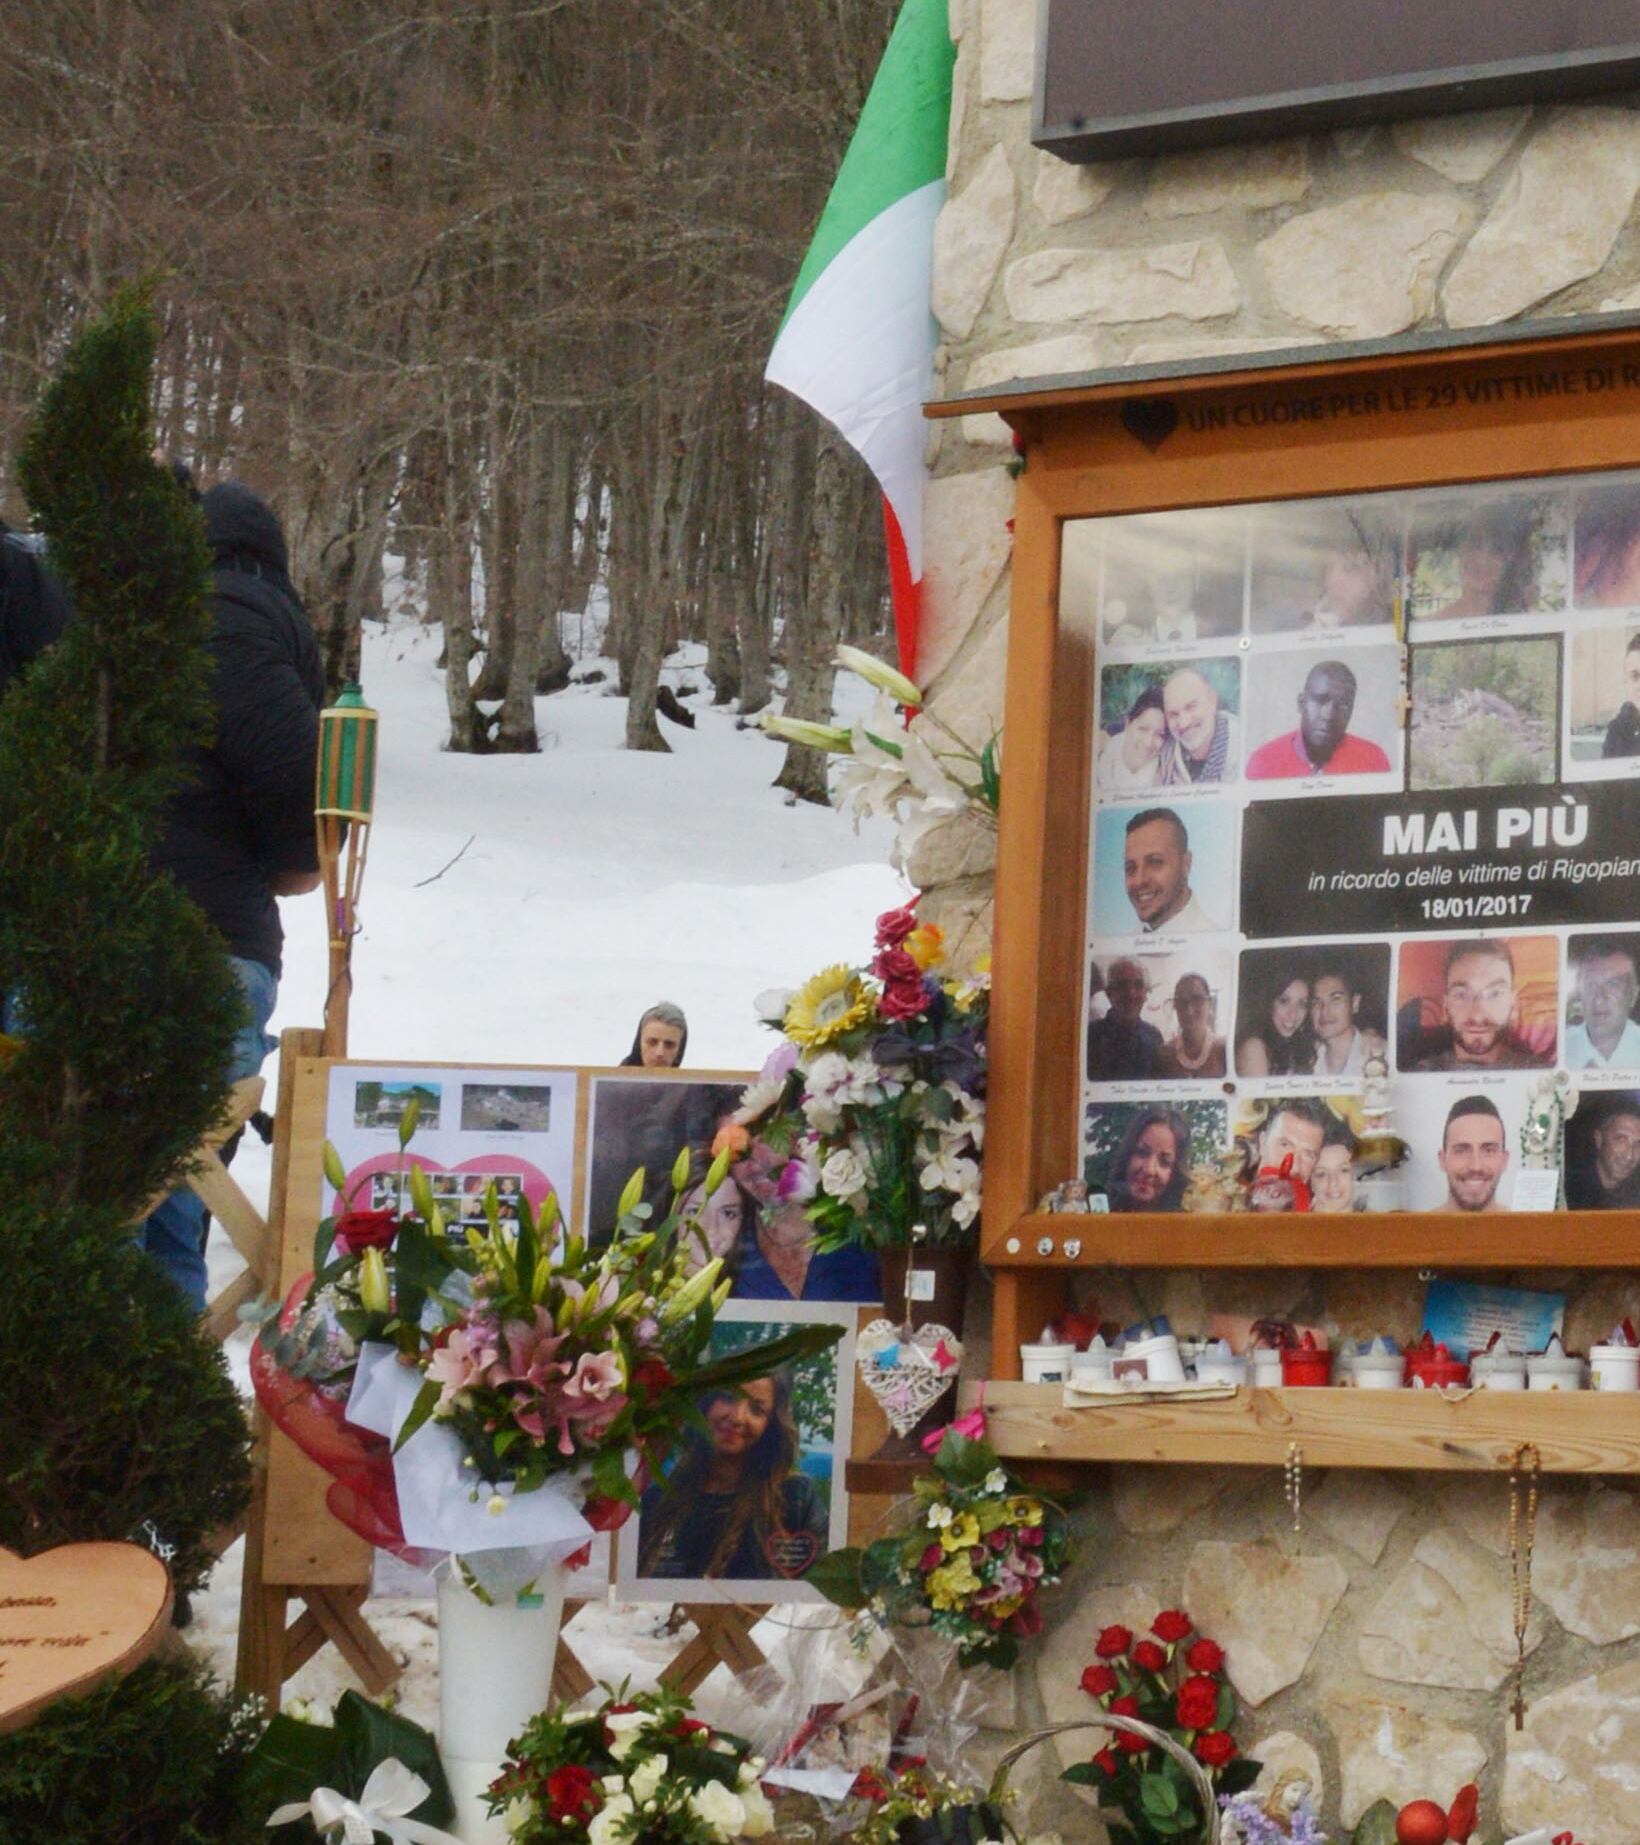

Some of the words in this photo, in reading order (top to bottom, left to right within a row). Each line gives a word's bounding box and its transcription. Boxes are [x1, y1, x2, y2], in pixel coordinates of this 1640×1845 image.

[1189, 403, 1227, 432] UN
[1233, 400, 1323, 425] CUORE
[1330, 390, 1380, 417] PER
[1387, 384, 1416, 412] LE
[1424, 384, 1458, 410] 29
[1465, 370, 1578, 402] VITTIME
[1583, 364, 1616, 393] DI
[1382, 810, 1478, 855] MAI
[1496, 794, 1588, 848] PIÙ
[1308, 871, 1326, 890] in
[1330, 867, 1400, 890] ricordo
[1405, 865, 1453, 886] delle
[1458, 861, 1522, 884] vittime
[1527, 860, 1548, 881] di
[1421, 894, 1532, 919] 18/01/2017
